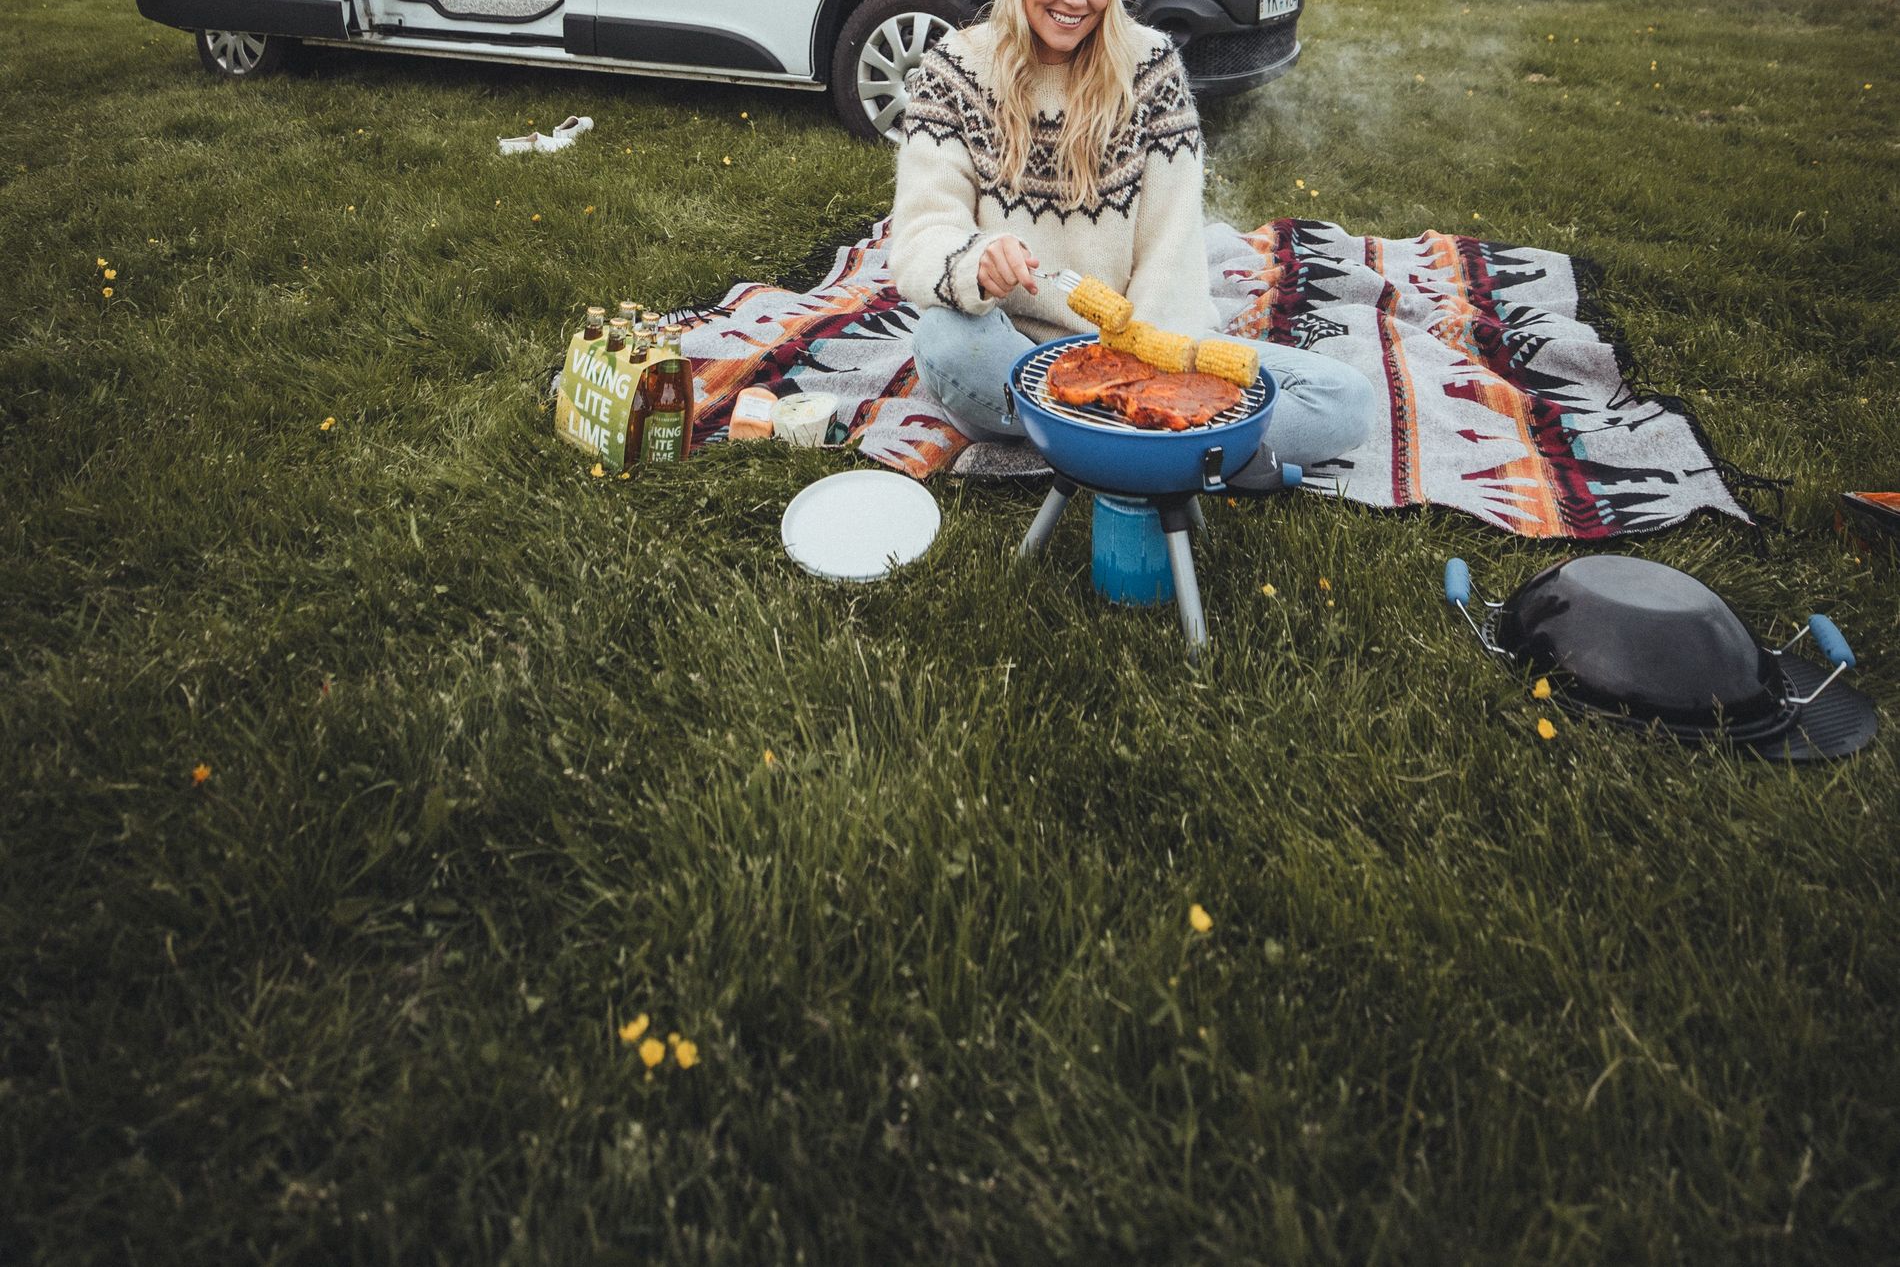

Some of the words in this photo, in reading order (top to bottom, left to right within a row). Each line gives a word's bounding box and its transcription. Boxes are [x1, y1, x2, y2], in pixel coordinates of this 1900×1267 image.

[572, 349, 631, 400] VÍKING
[574, 383, 612, 423] LITE
[568, 410, 610, 455] LIME
